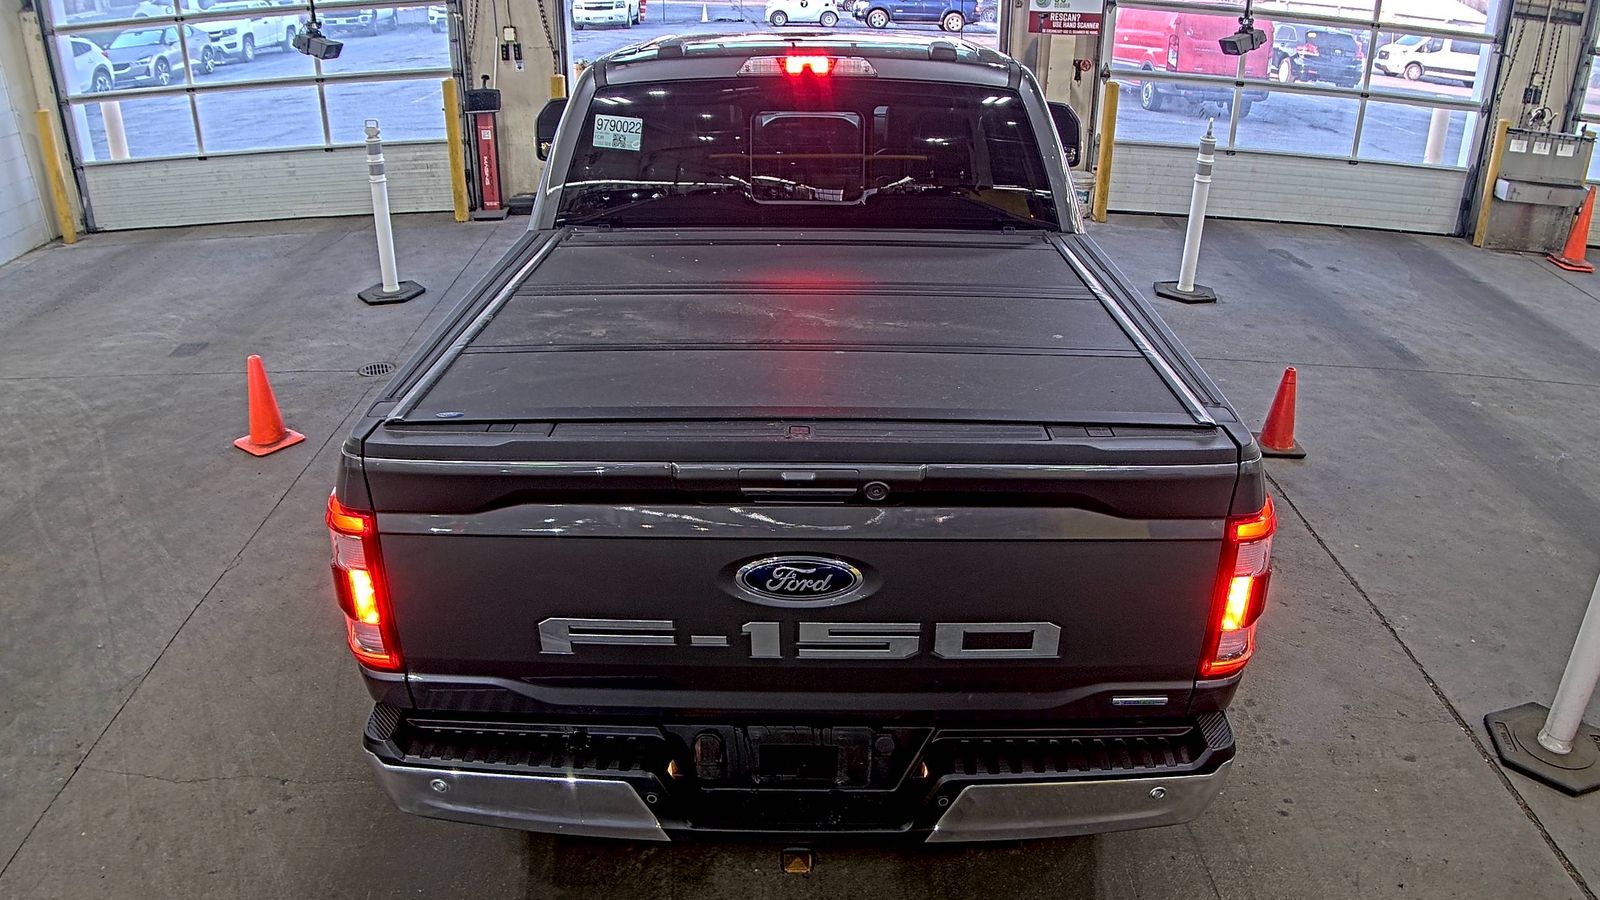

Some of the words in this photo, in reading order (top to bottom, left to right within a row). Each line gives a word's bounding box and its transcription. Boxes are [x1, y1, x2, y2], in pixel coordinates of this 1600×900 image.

[1050, 12, 1081, 22] RESCAN?
[596, 118, 641, 134] 9790022
[765, 566, 833, 592] Ford
[538, 617, 1061, 659] F-150
